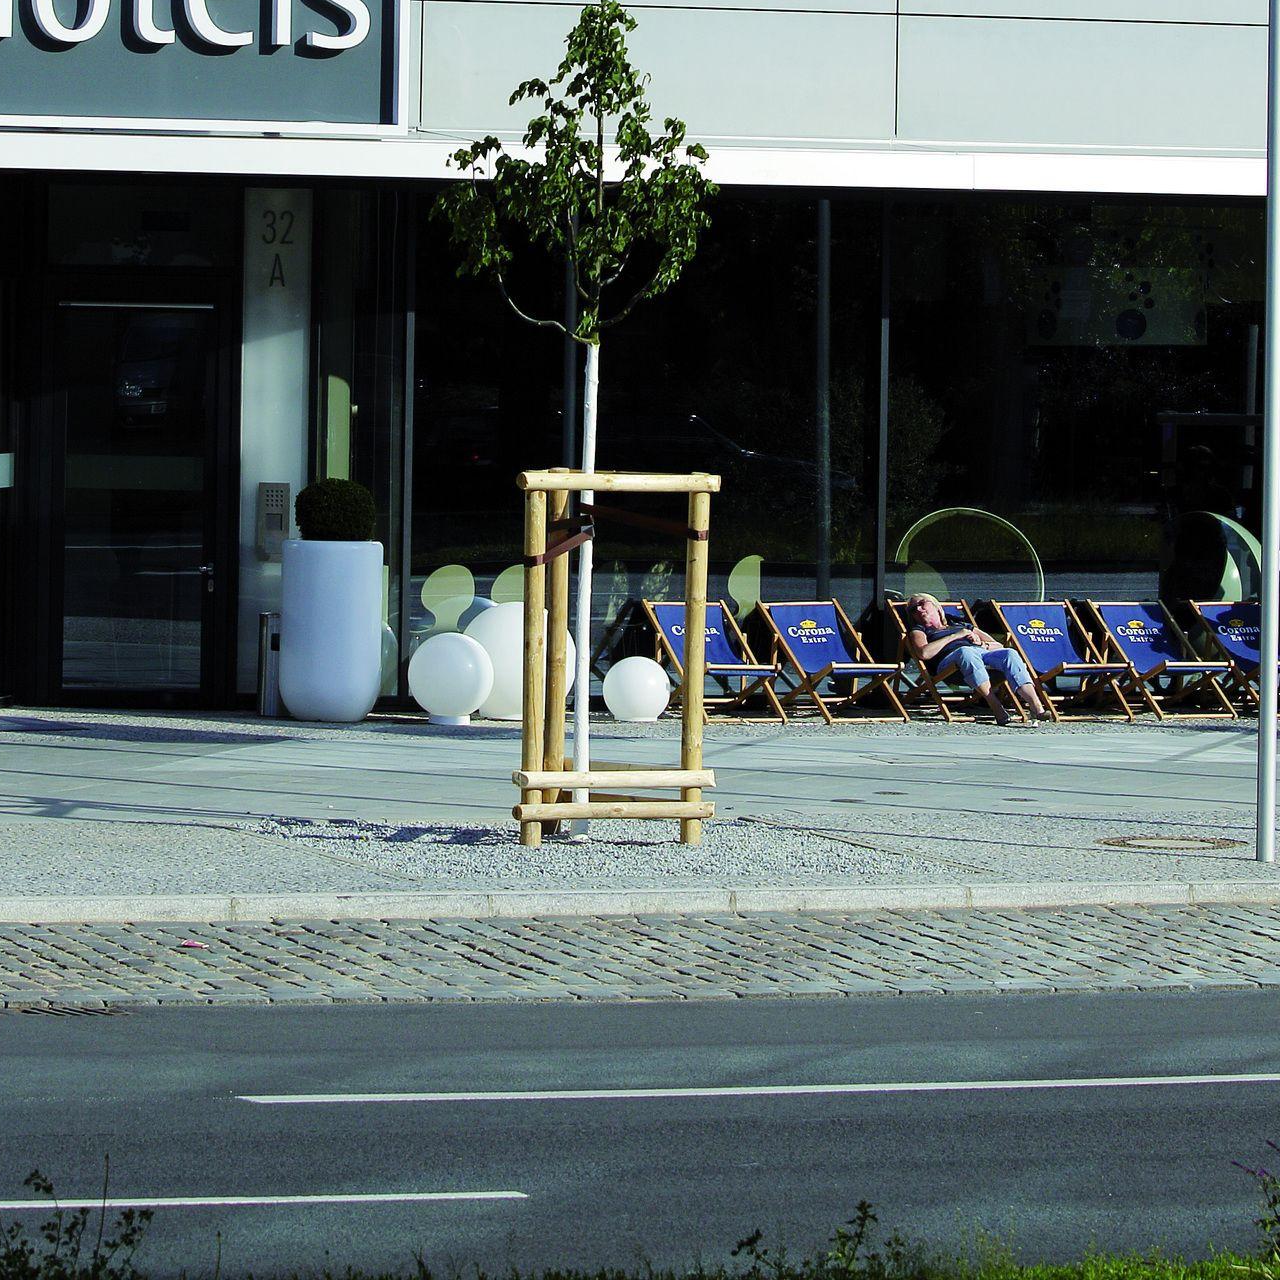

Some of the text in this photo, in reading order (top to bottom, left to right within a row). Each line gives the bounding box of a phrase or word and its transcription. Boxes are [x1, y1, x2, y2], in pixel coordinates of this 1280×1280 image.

[262, 210, 294, 244] 32
[269, 253, 286, 287] A
[788, 626, 836, 637] Corona
[1017, 624, 1063, 636] Corona
[1116, 625, 1162, 636] Corona
[1218, 624, 1260, 635] Corona
